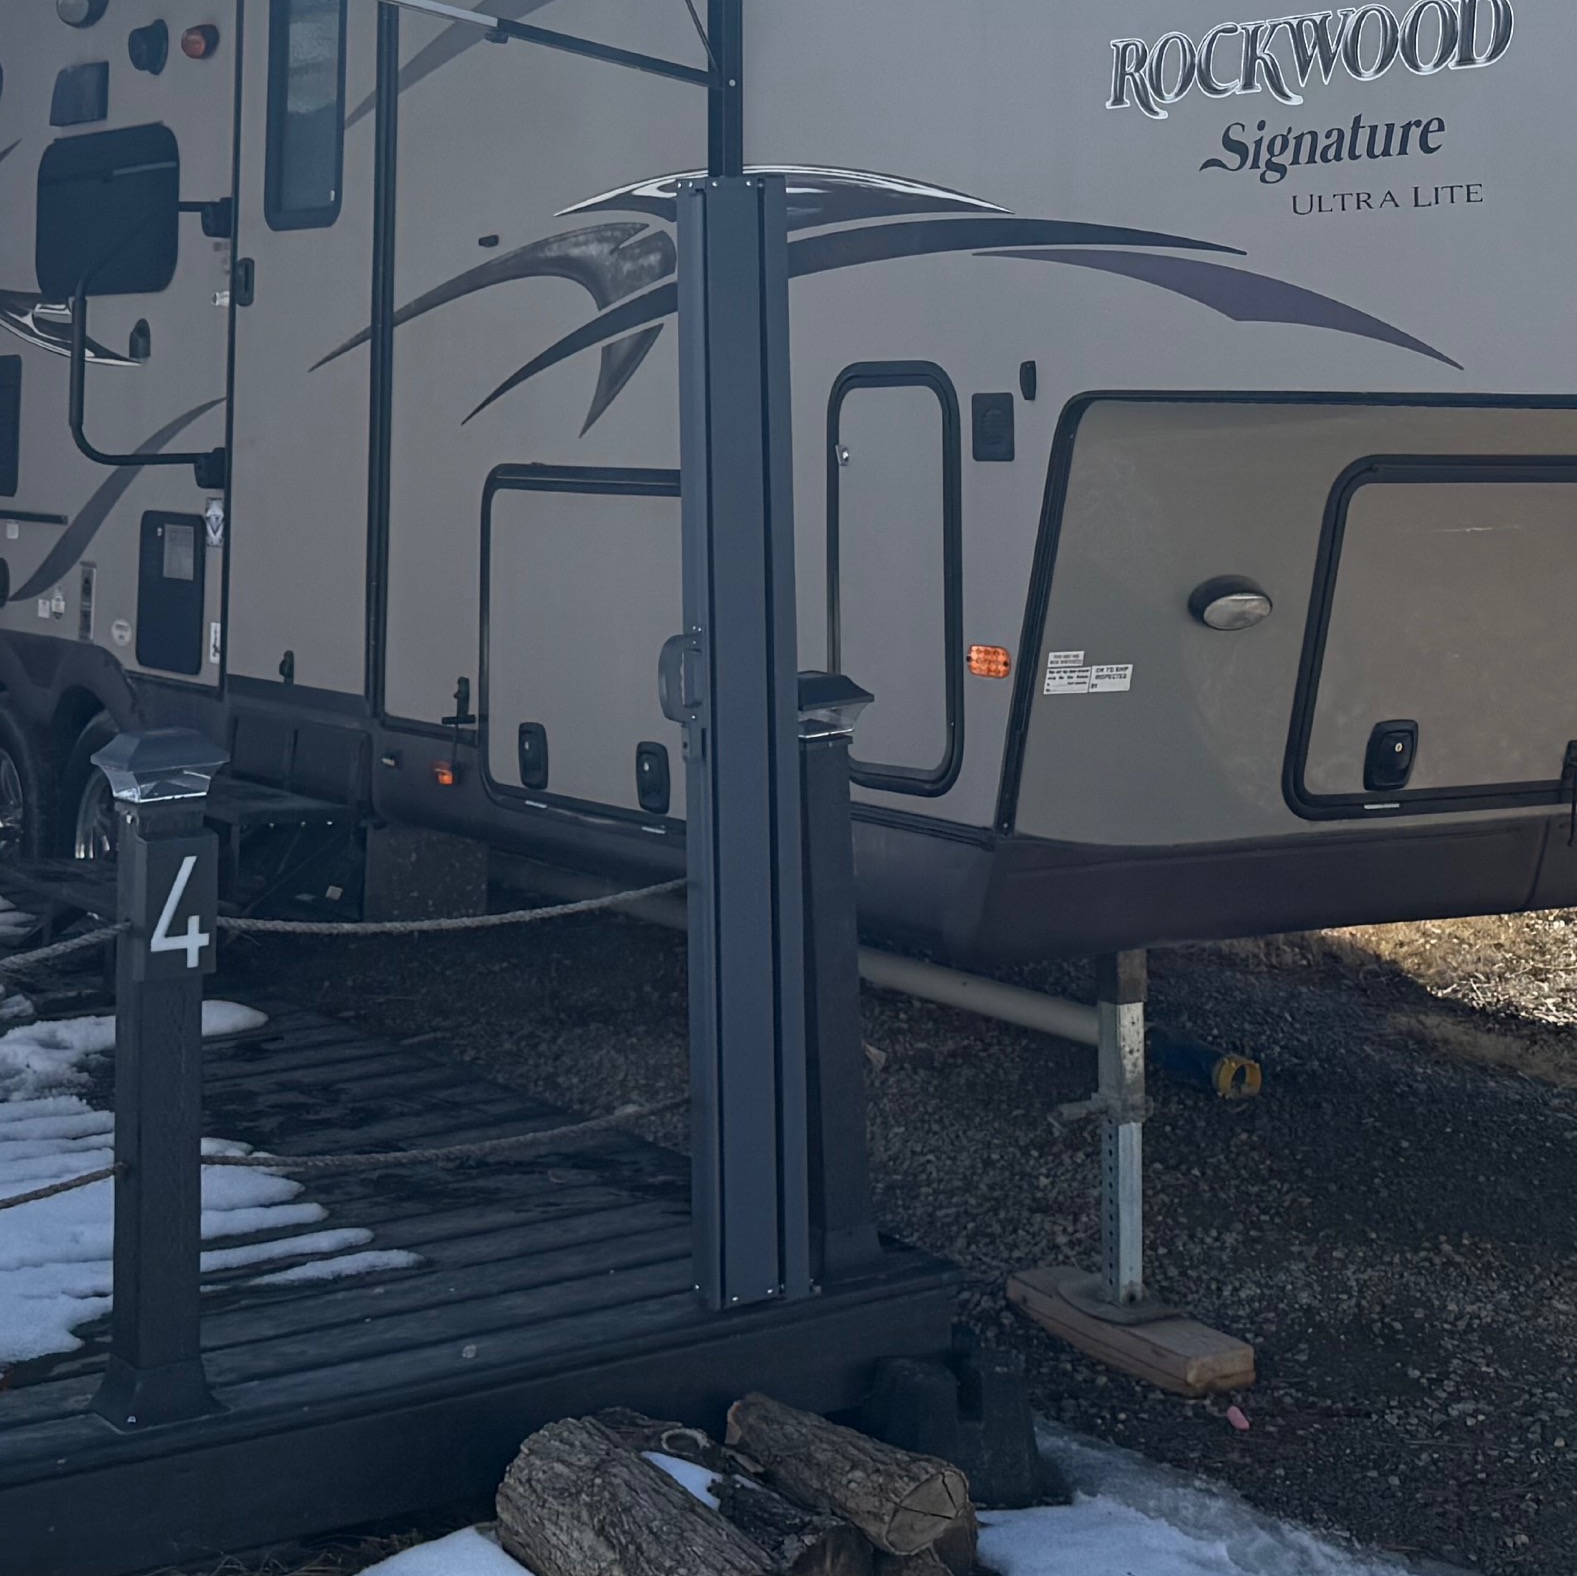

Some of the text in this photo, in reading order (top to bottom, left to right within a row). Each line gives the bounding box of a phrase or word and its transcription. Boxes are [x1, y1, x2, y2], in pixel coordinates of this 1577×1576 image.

[1198, 113, 1446, 184] Signature
[1291, 183, 1484, 216] ULTRA LITE
[150, 855, 210, 969] 4
